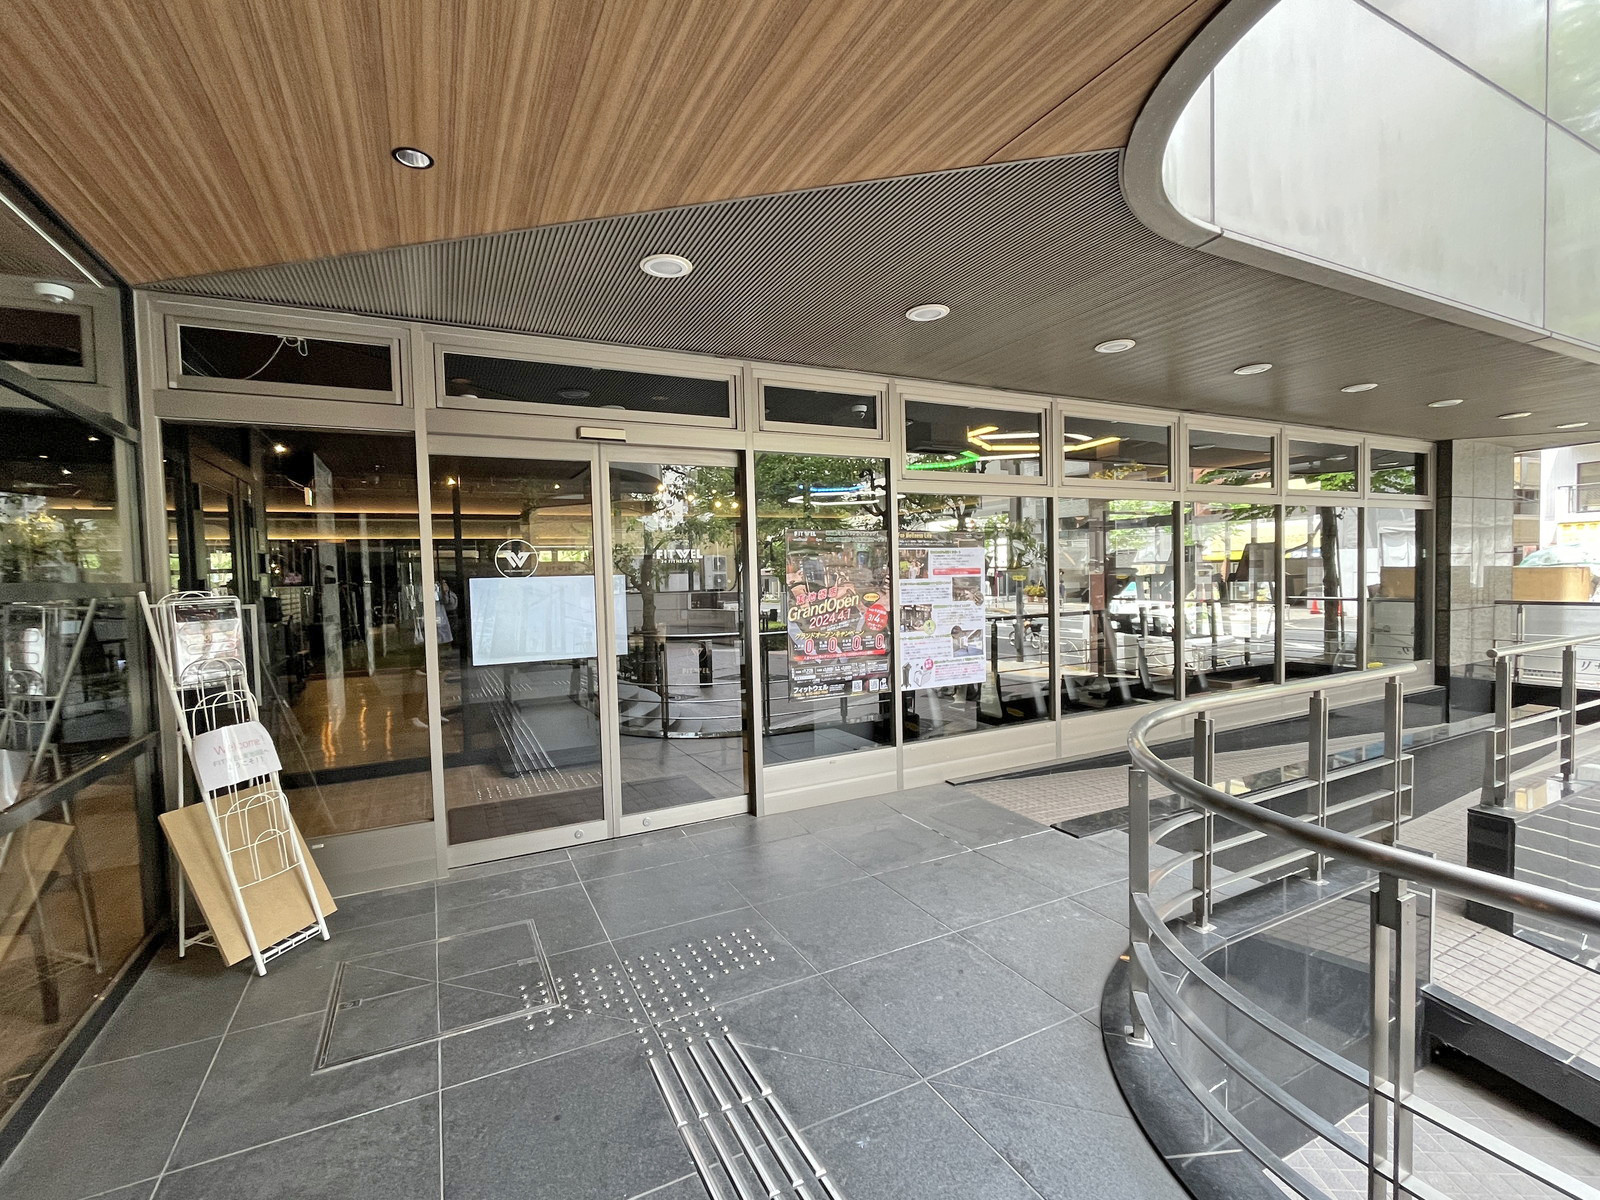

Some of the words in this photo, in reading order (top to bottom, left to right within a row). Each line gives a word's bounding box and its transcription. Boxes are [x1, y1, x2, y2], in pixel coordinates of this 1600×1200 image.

[656, 548, 703, 560] FITWEL
[787, 594, 860, 622] GrandOpen
[808, 608, 852, 629] 2024.4.1
[793, 684, 829, 694] フィットウェル
